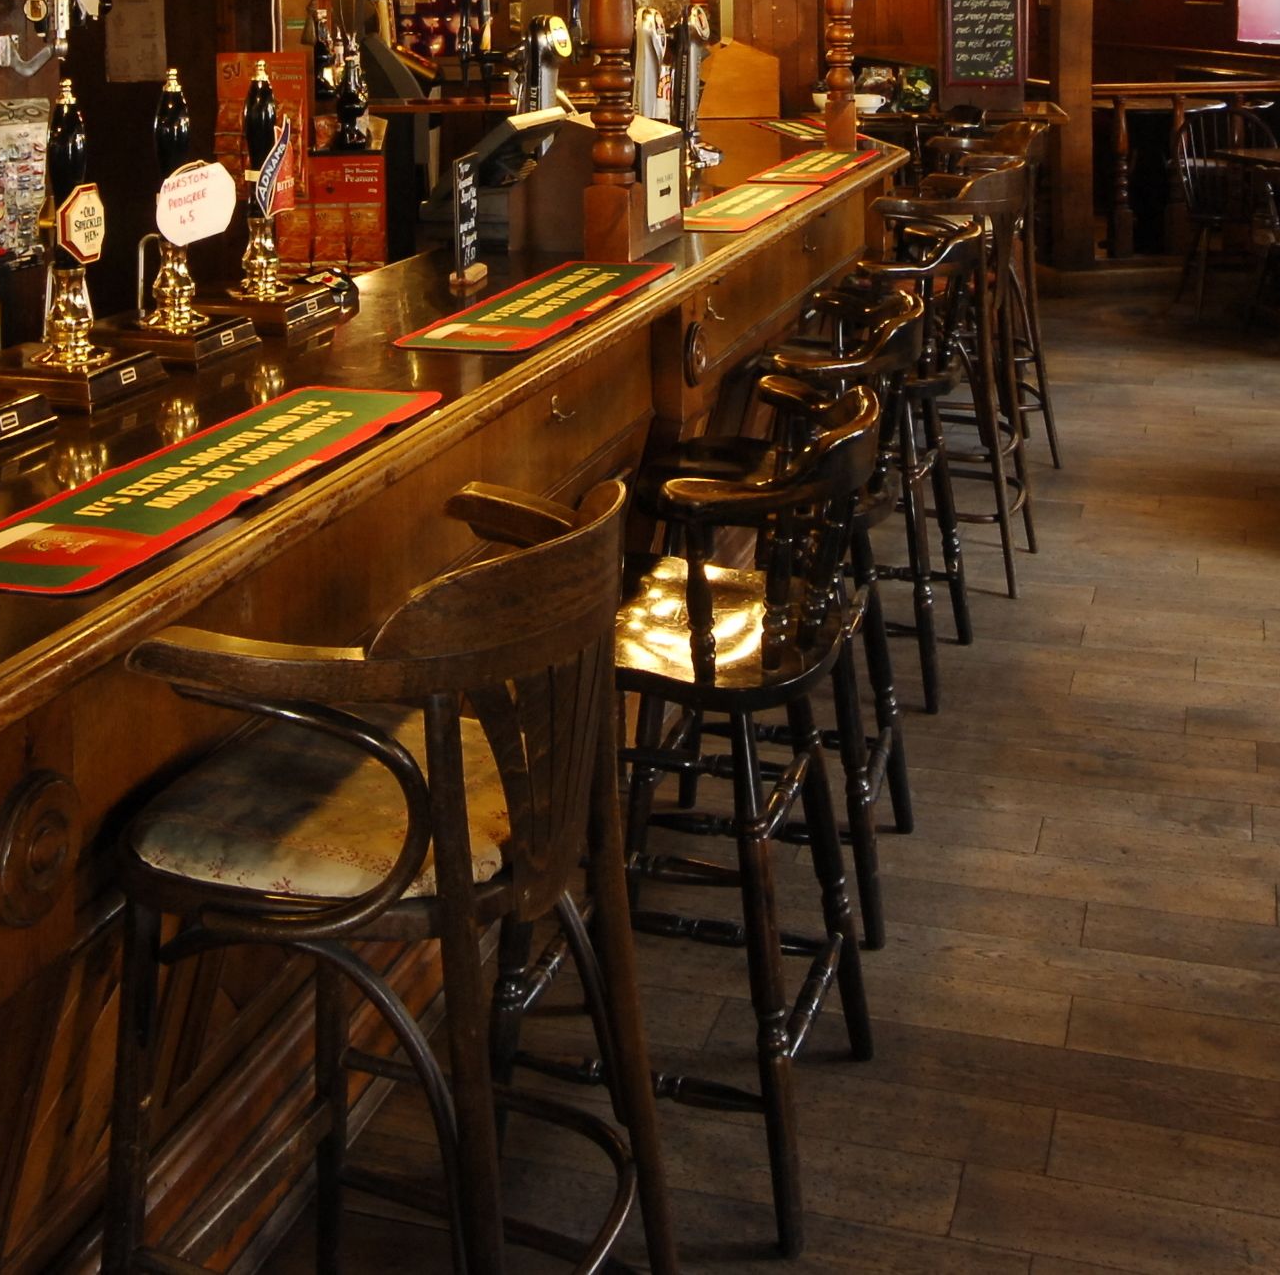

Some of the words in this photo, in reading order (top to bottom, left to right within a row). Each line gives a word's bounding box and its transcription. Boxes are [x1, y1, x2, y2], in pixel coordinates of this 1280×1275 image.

[256, 143, 287, 201] ADNAMS
[74, 496, 133, 518] IT'S
[116, 466, 197, 497] EXTRA
[180, 431, 269, 466] SMOOTH
[254, 413, 302, 433] AND
[288, 400, 332, 416] IT'S
[144, 479, 220, 509] MADE
[202, 464, 246, 481] BY
[232, 440, 295, 466] JOHN
[278, 410, 354, 443] SMITH'S
